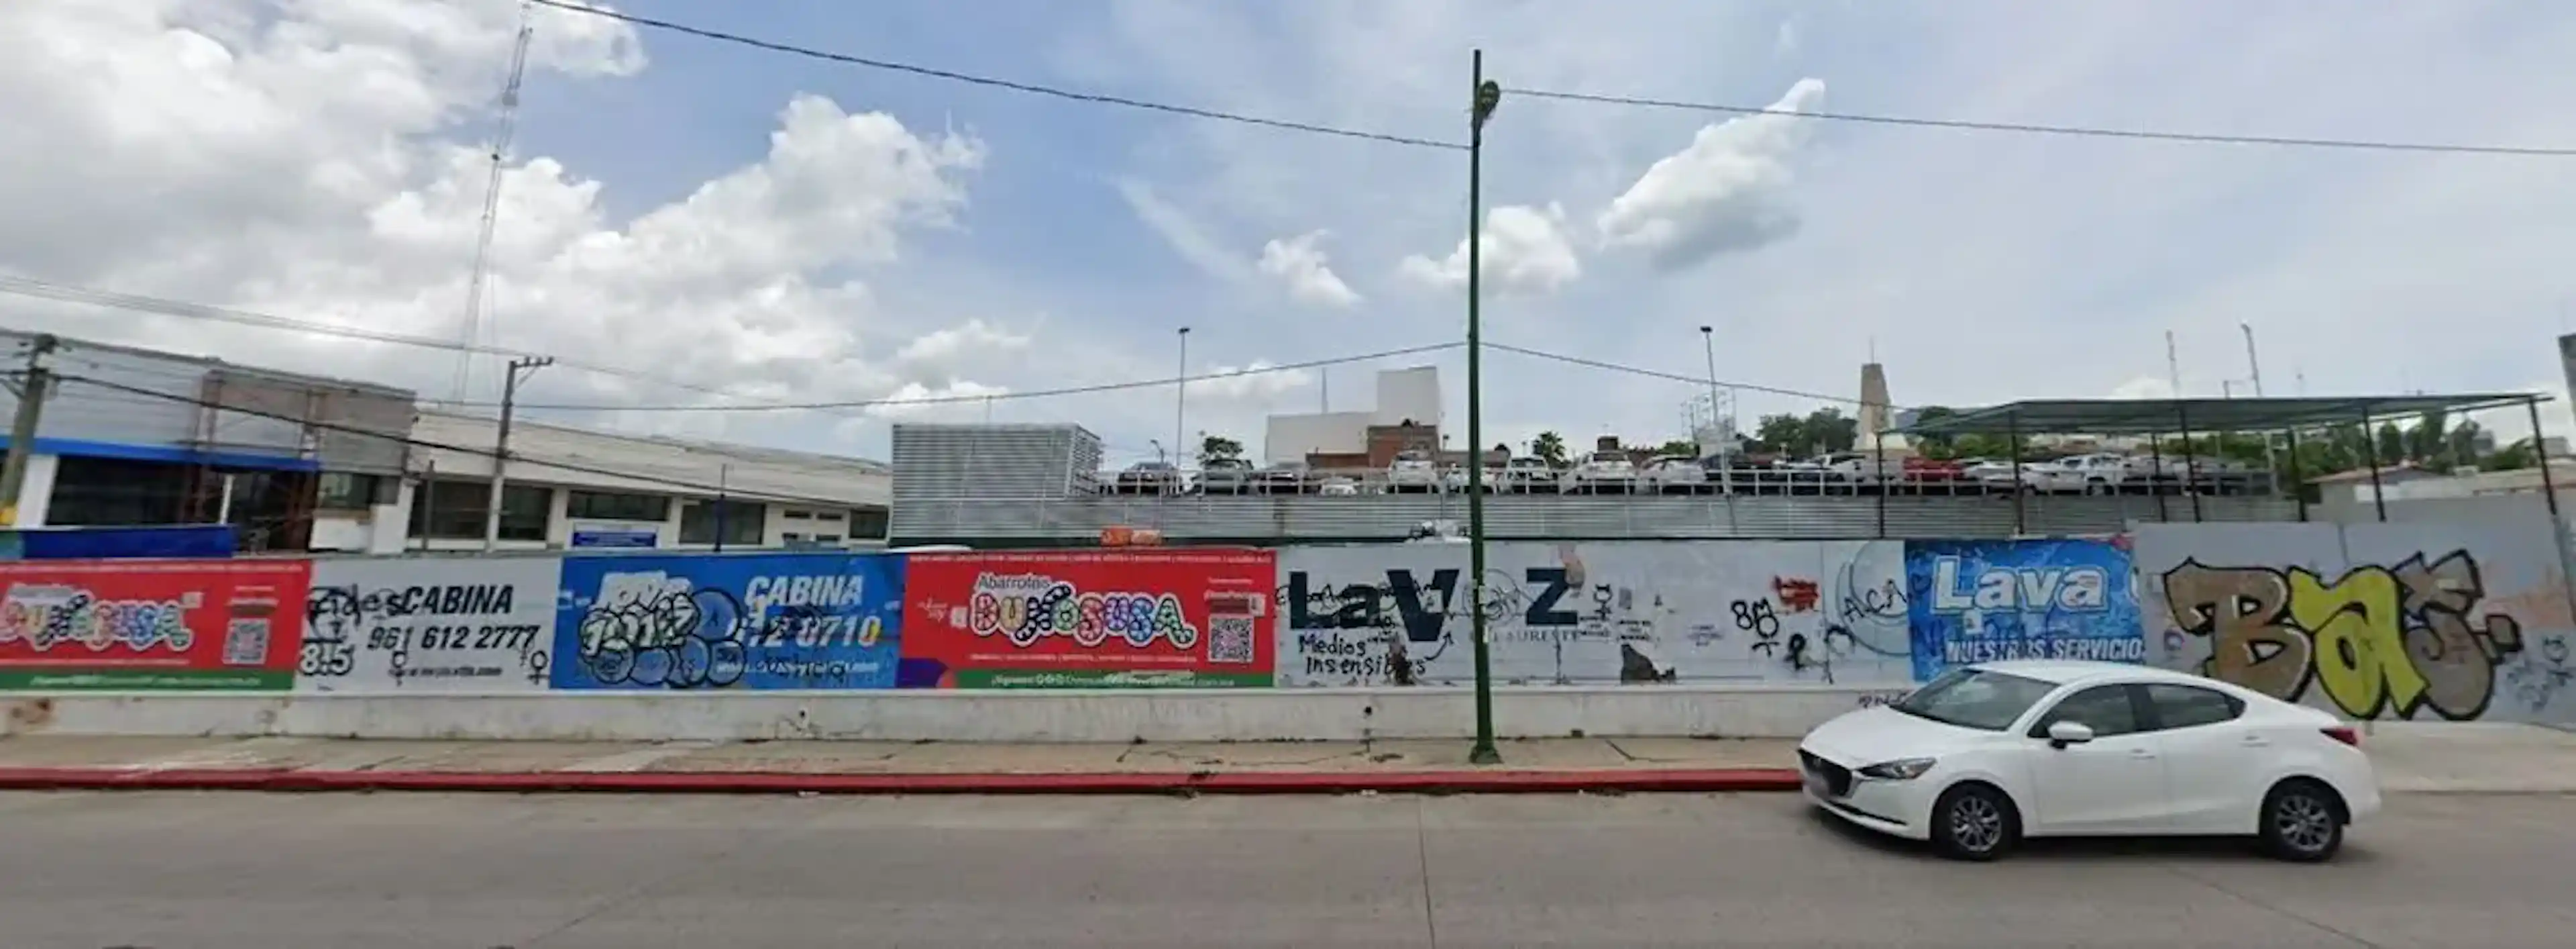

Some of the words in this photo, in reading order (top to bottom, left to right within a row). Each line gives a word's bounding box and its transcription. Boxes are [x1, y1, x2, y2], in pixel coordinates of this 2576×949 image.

[745, 576, 863, 607] CABINA
[979, 577, 1050, 589] Abarrotes
[1933, 556, 2107, 611] Lava
[399, 586, 514, 614] CABINA
[367, 626, 414, 650] 961
[421, 626, 470, 649] 612
[474, 624, 541, 649] 2777
[1299, 634, 1366, 656] Medios
